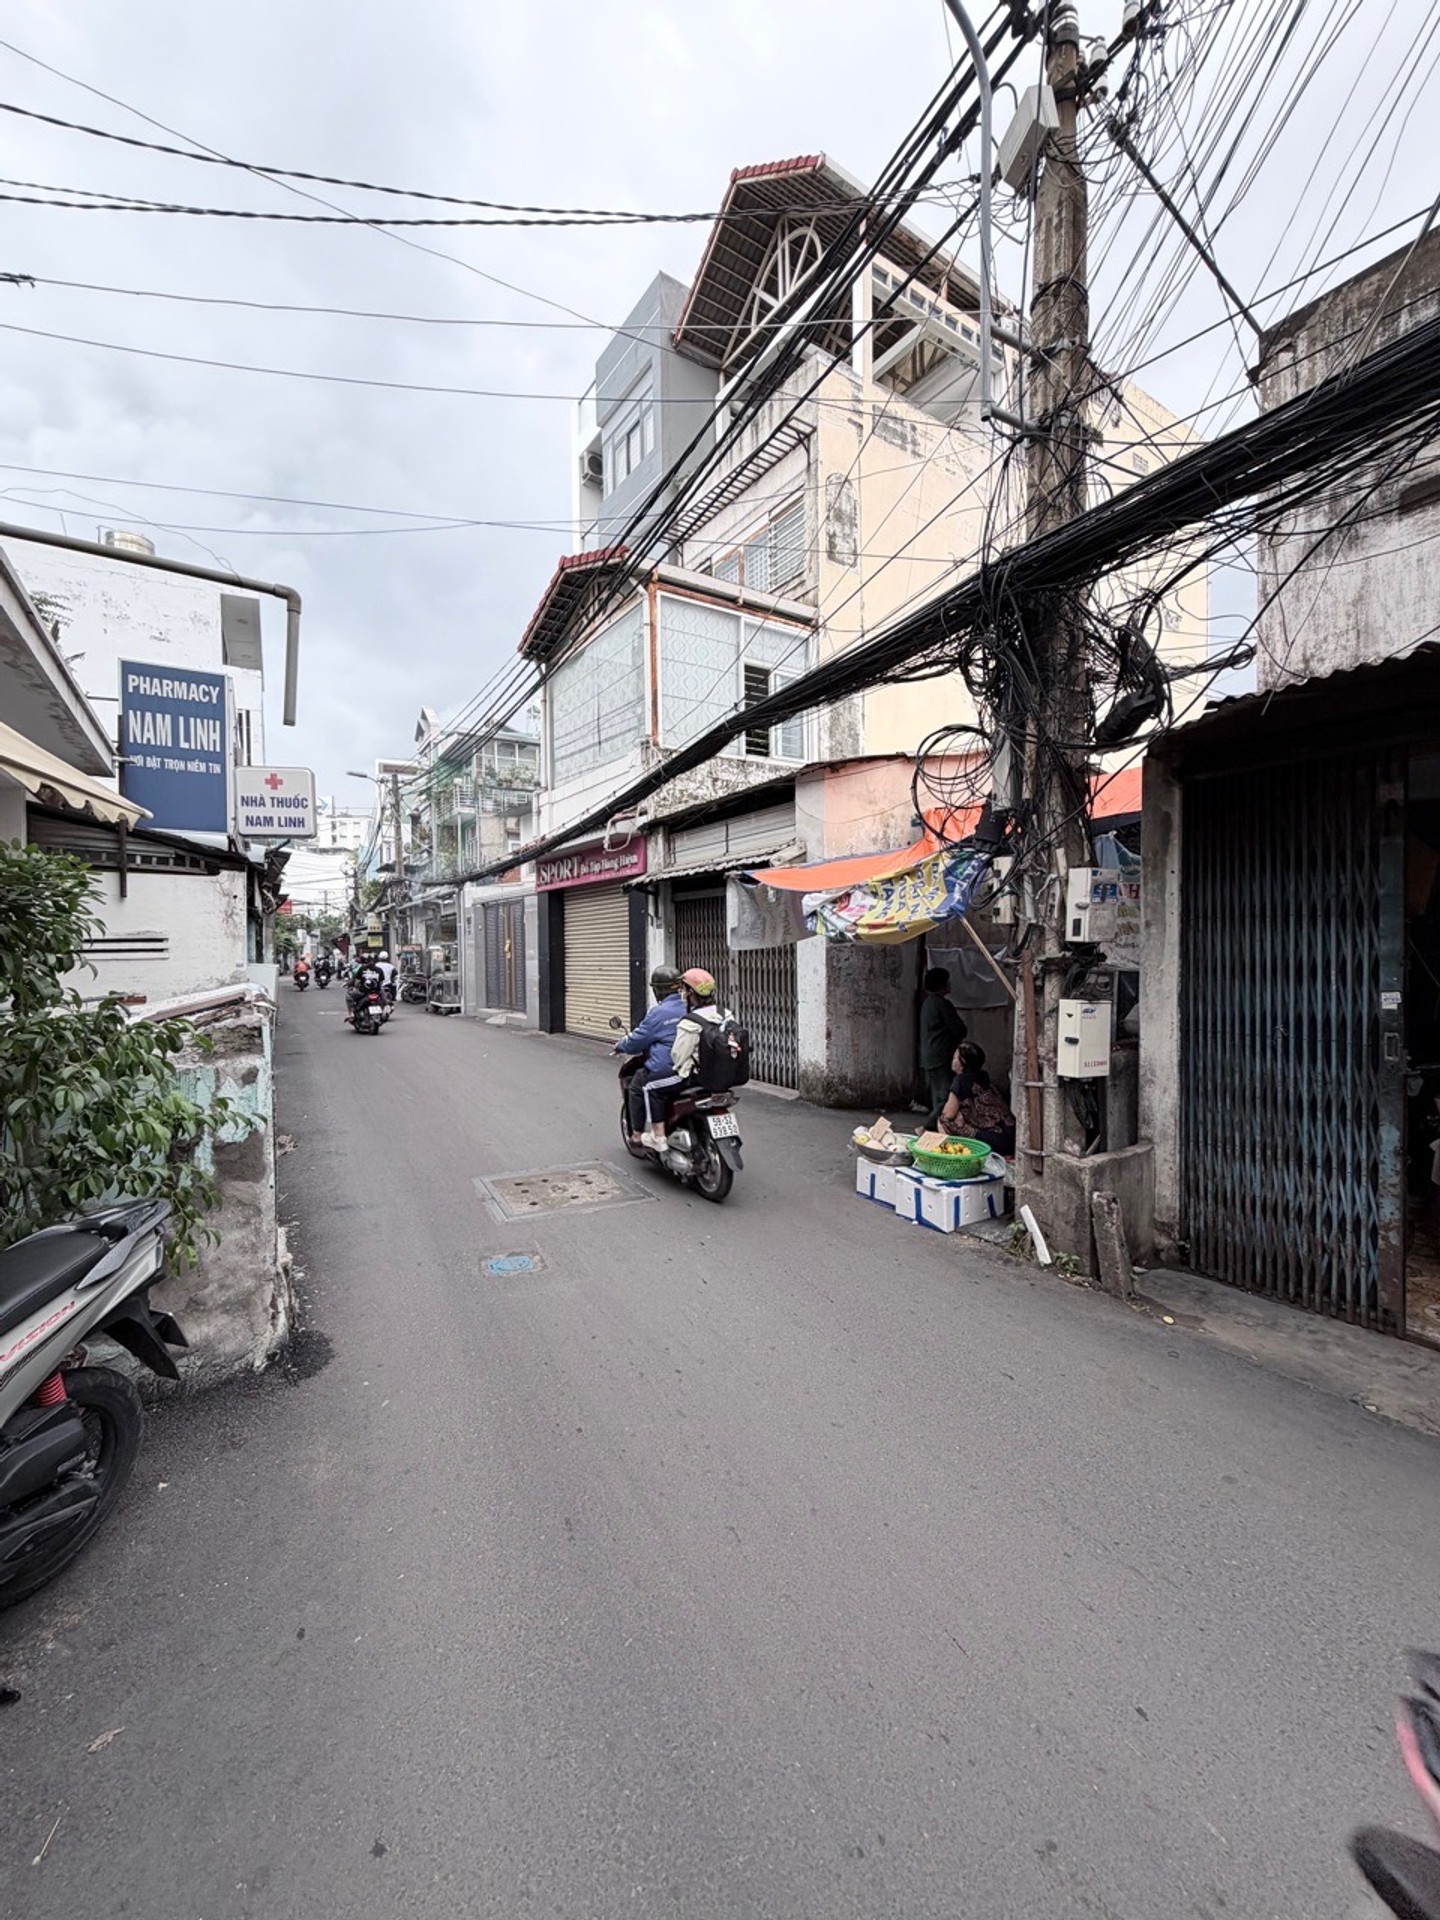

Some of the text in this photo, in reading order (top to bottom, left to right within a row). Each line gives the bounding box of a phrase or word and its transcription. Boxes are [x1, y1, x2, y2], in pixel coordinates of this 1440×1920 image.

[128, 674, 220, 704] PHARMACY
[128, 709, 221, 752] NAM LINH
[209, 761, 221, 774] TIN
[240, 793, 309, 809] NHÀ THUỐC
[245, 815, 305, 828] NAM LINH
[540, 856, 582, 884] SPORT
[0, 1300, 75, 1361] VISION
